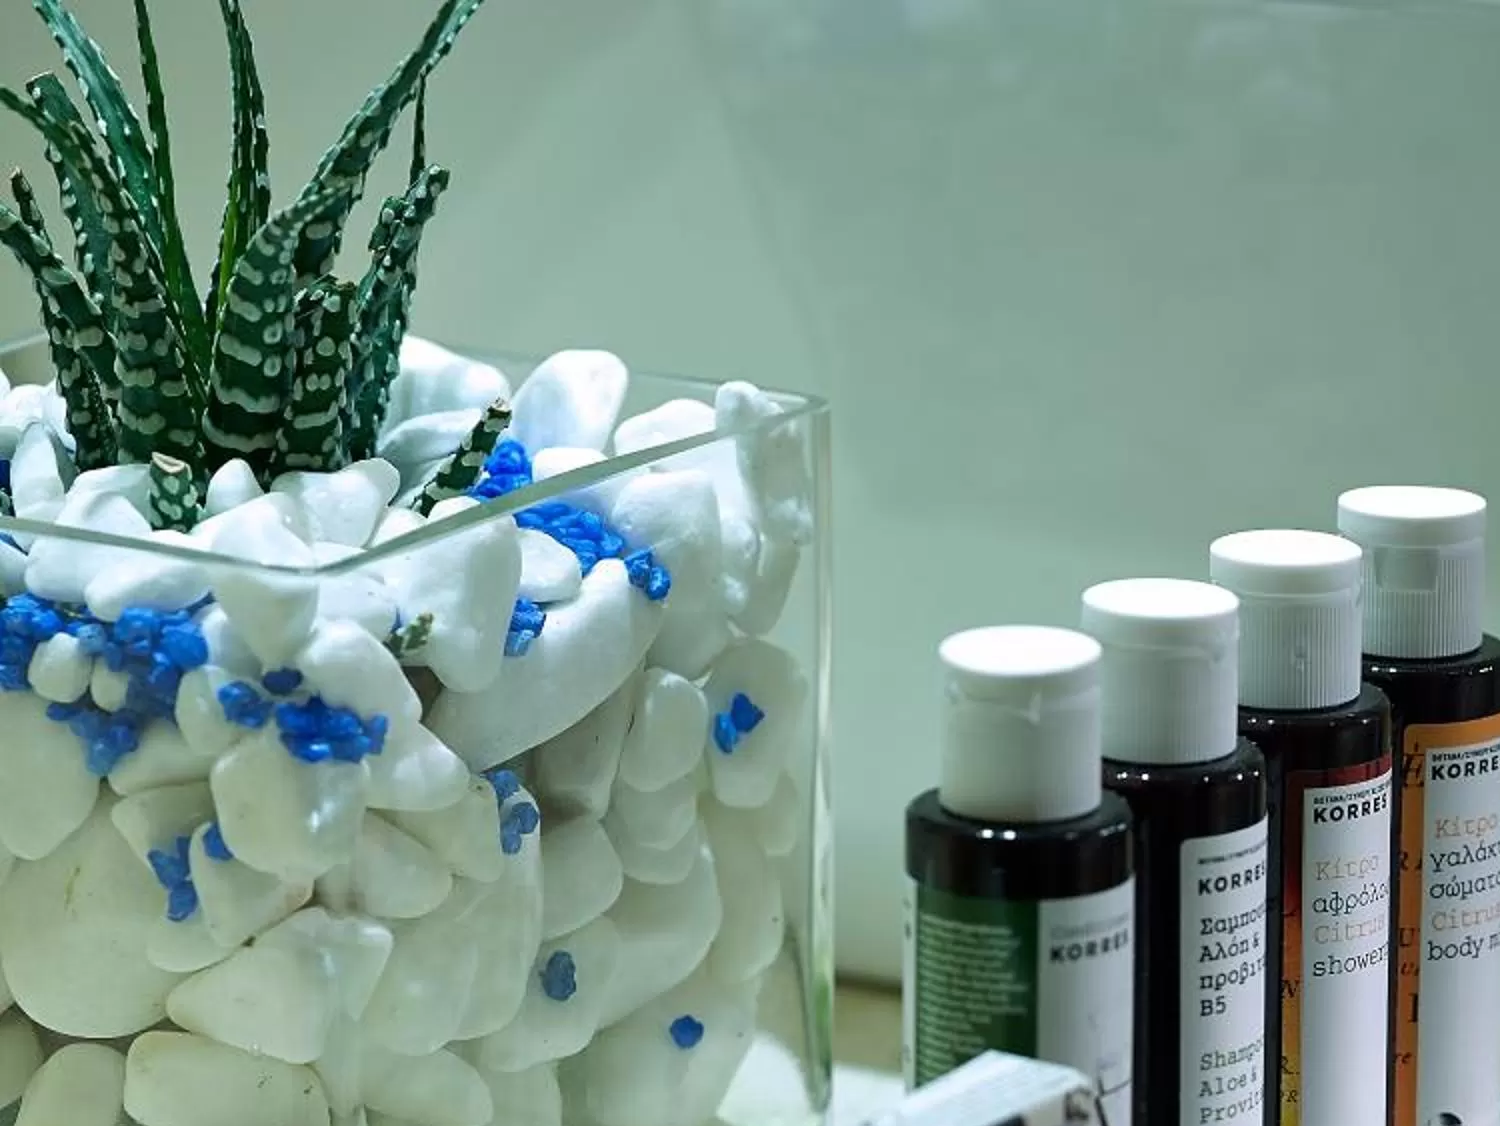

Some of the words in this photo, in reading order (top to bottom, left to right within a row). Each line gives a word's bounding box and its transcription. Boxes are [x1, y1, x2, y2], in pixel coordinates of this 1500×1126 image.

[1313, 792, 1388, 824] KORRES
[1427, 935, 1485, 961] body
[1200, 995, 1227, 1018] B5
[1199, 1073, 1248, 1098] Aloe
